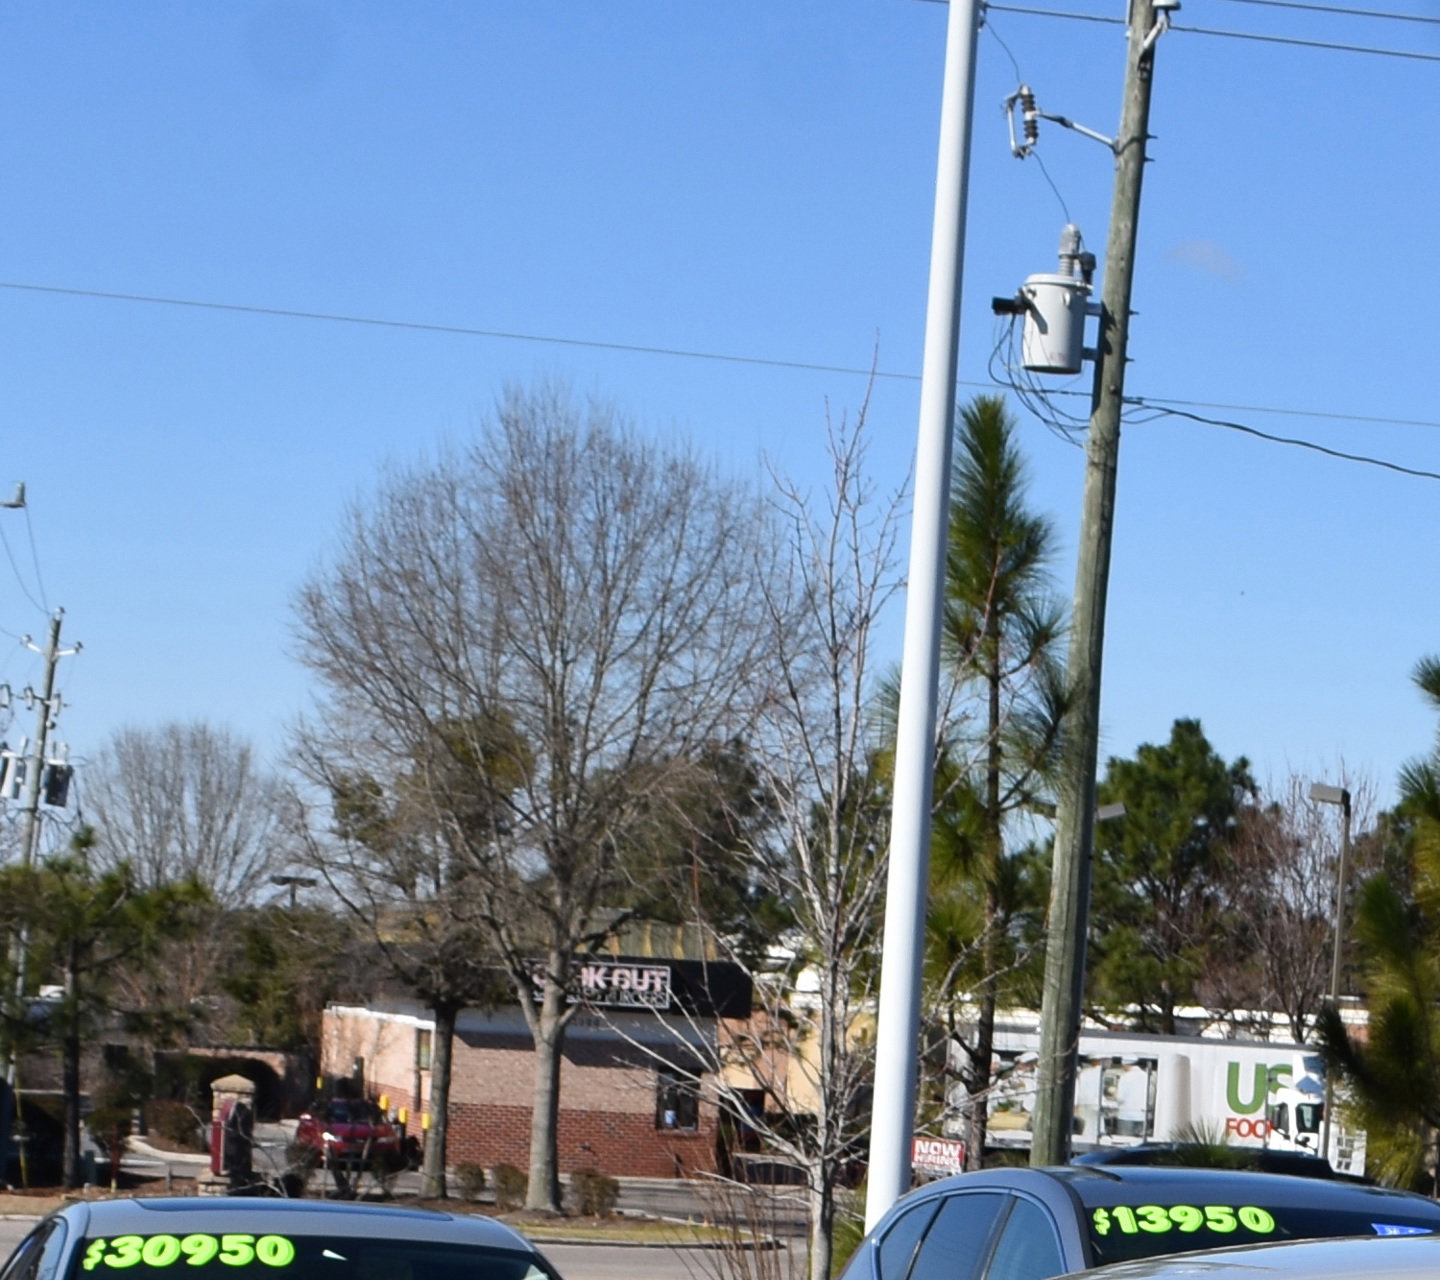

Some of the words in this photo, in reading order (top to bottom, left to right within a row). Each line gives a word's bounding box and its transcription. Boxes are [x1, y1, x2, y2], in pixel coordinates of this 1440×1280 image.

[1225, 1118, 1273, 1139] FOO
[914, 1139, 961, 1157] NOW
[1092, 1205, 1276, 1236] $13950
[83, 1233, 295, 1271] $30950
